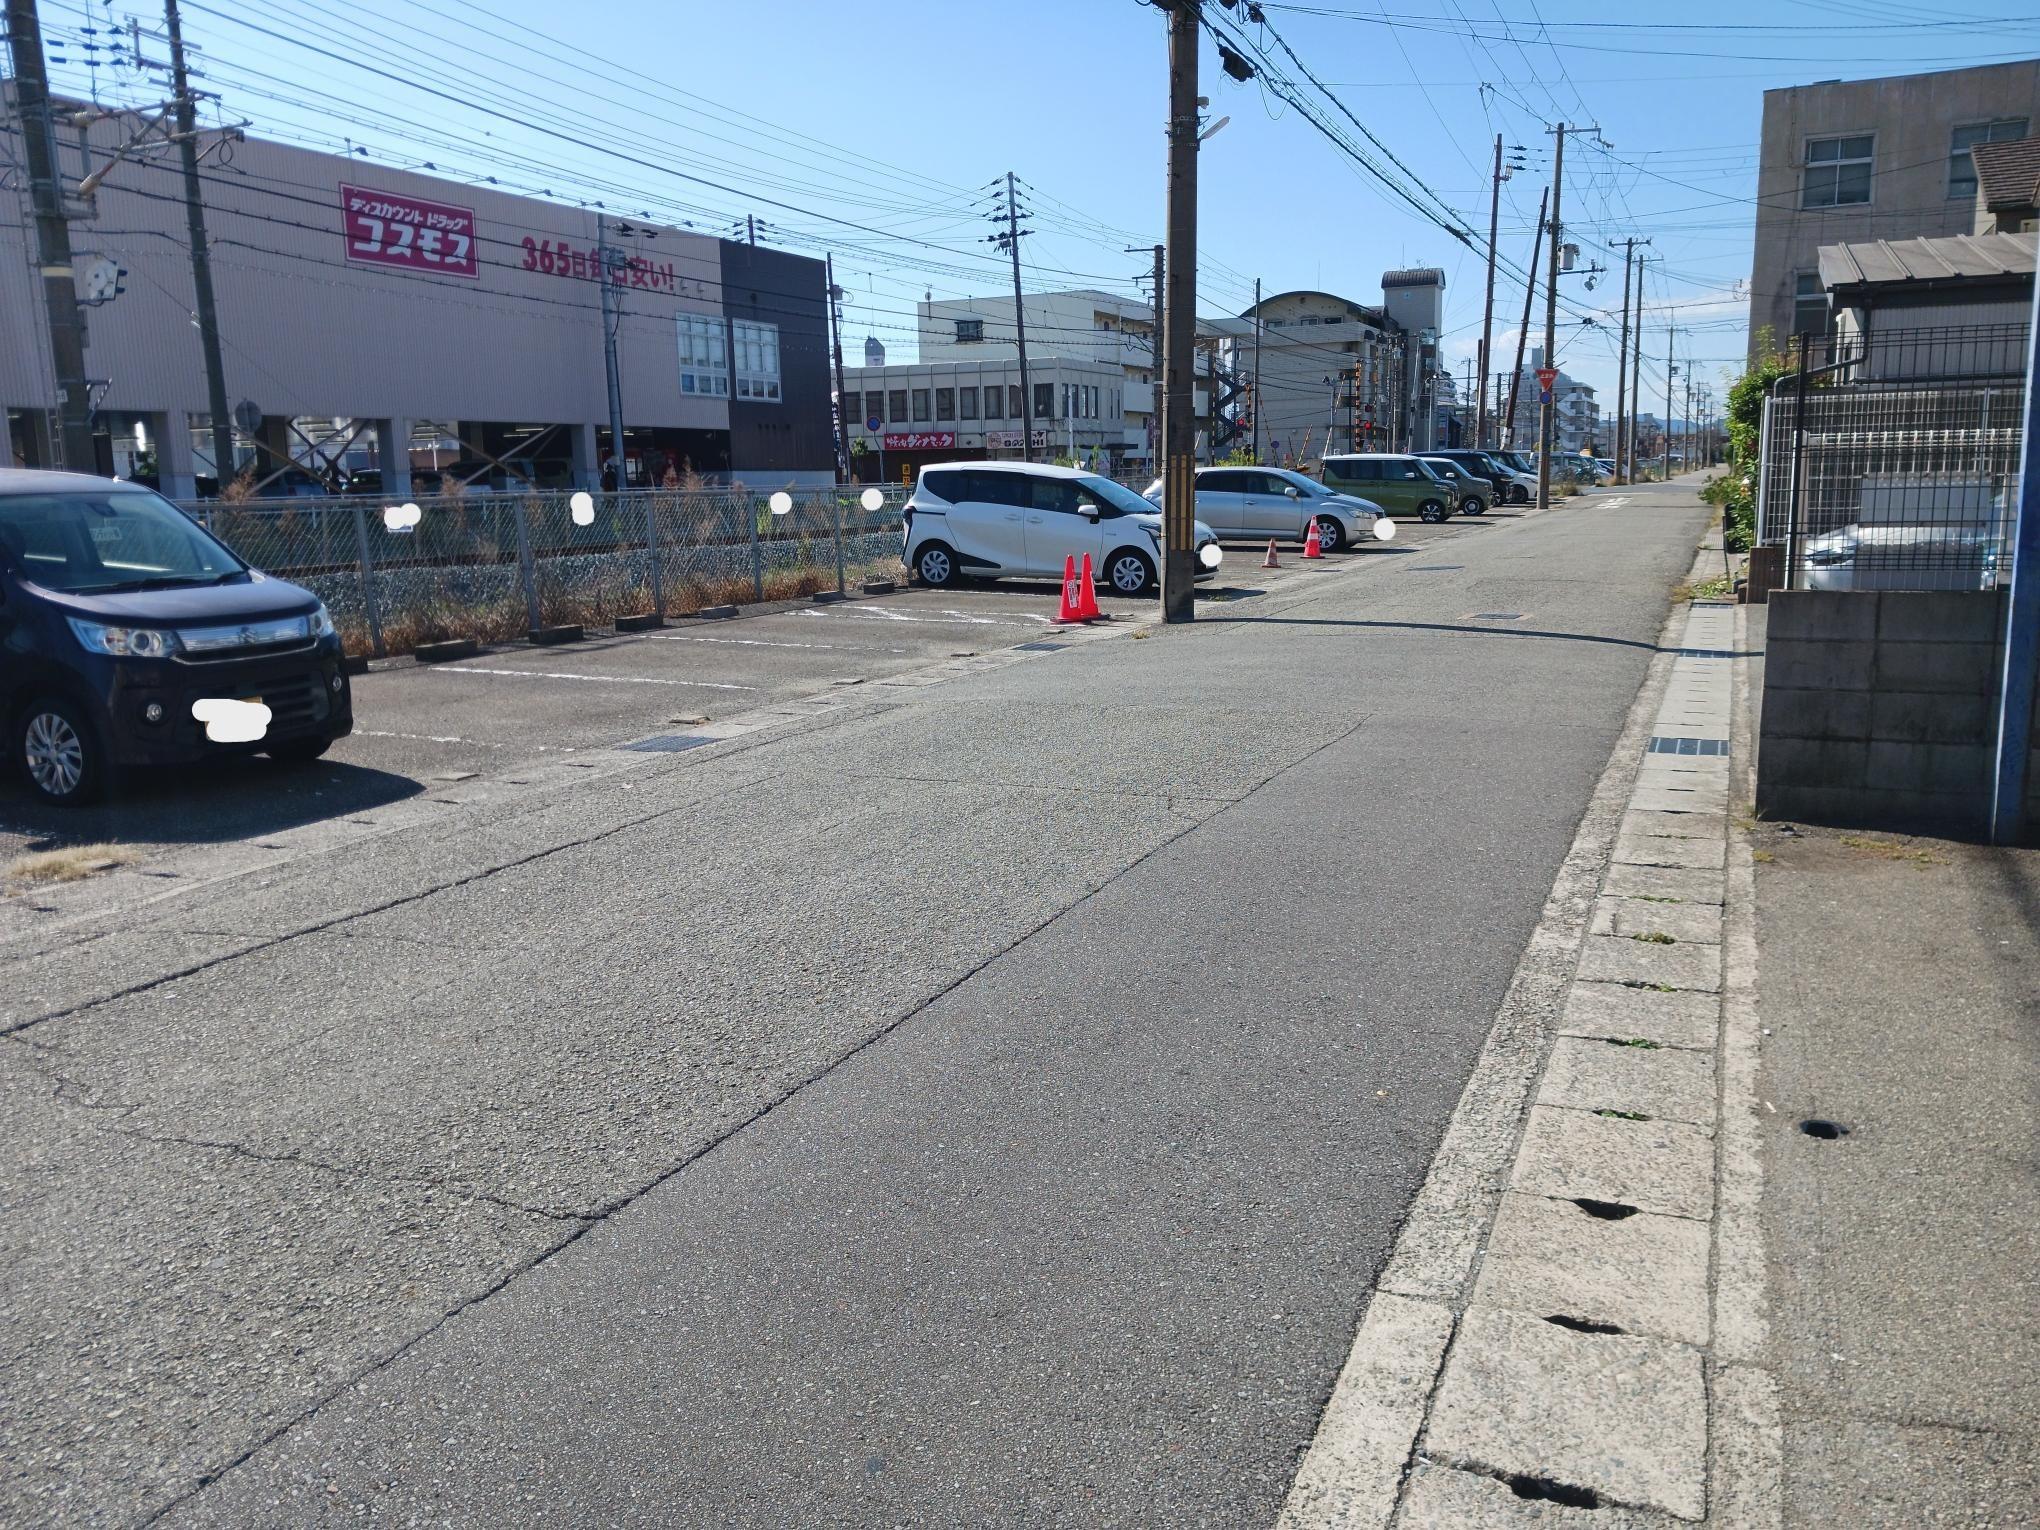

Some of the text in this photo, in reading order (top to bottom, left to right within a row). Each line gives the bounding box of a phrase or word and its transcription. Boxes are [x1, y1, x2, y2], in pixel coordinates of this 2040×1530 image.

[350, 198, 468, 230] ディスカウント ドラッグ
[354, 217, 469, 267] コスモス
